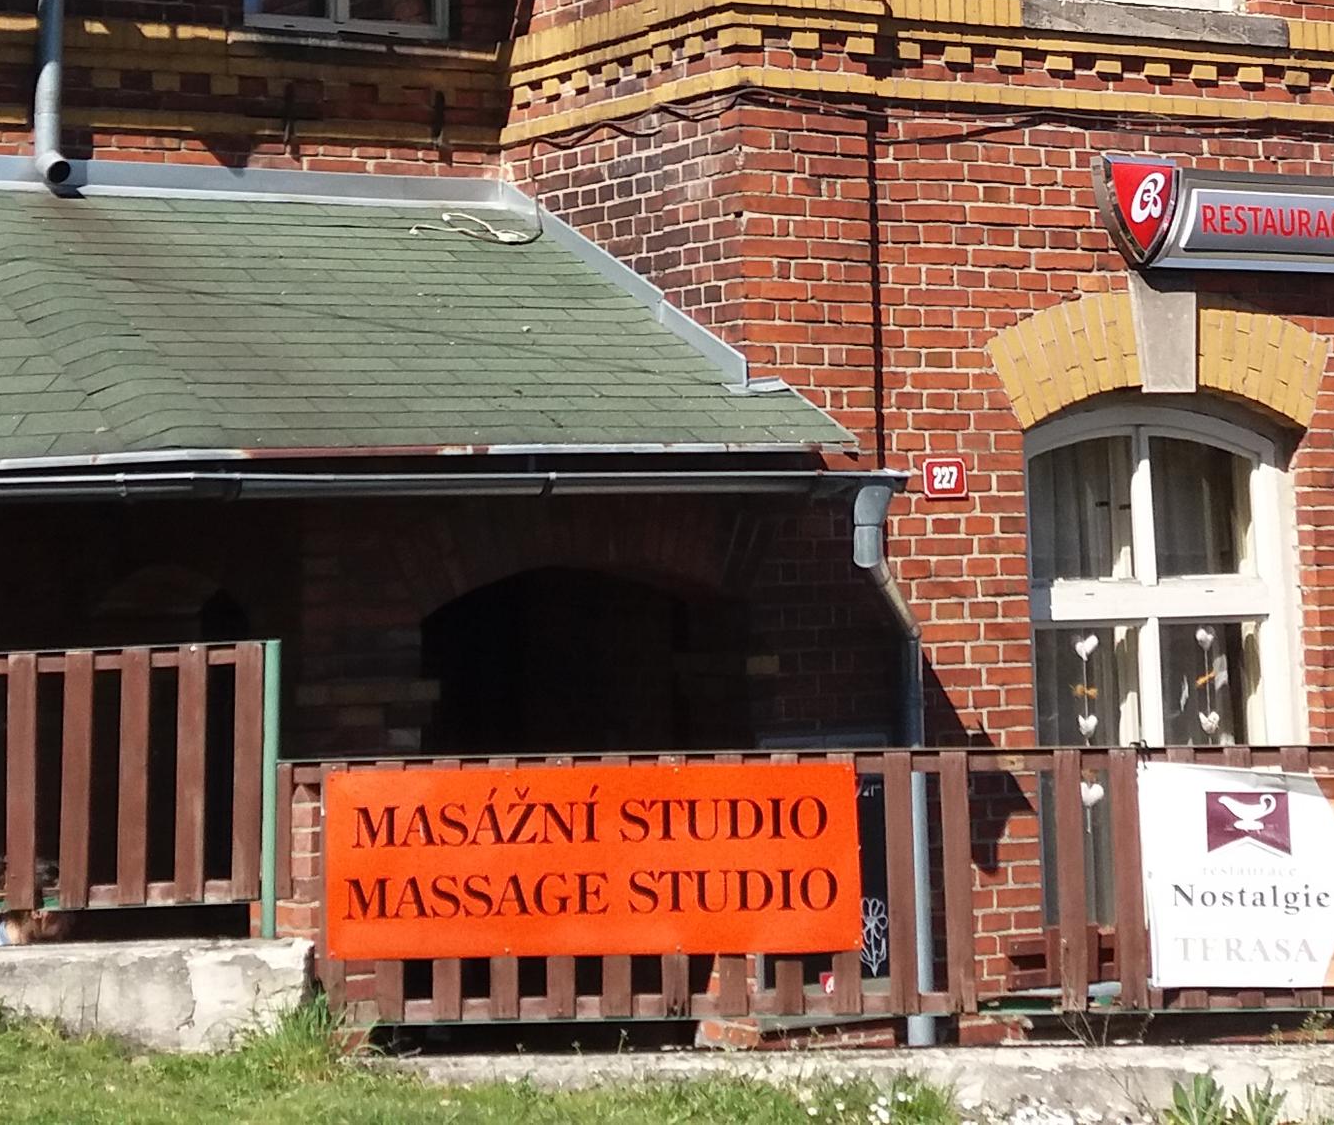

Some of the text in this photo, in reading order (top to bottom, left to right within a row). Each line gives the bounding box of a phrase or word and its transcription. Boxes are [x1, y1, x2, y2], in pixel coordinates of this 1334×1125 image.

[932, 466, 958, 490] 227
[351, 784, 828, 849] MASÁŽNÍ STUDIO
[342, 867, 838, 921] MASSAGE STUDIO
[1171, 883, 1332, 916] Nostalgie
[1174, 936, 1319, 964] TERASA
